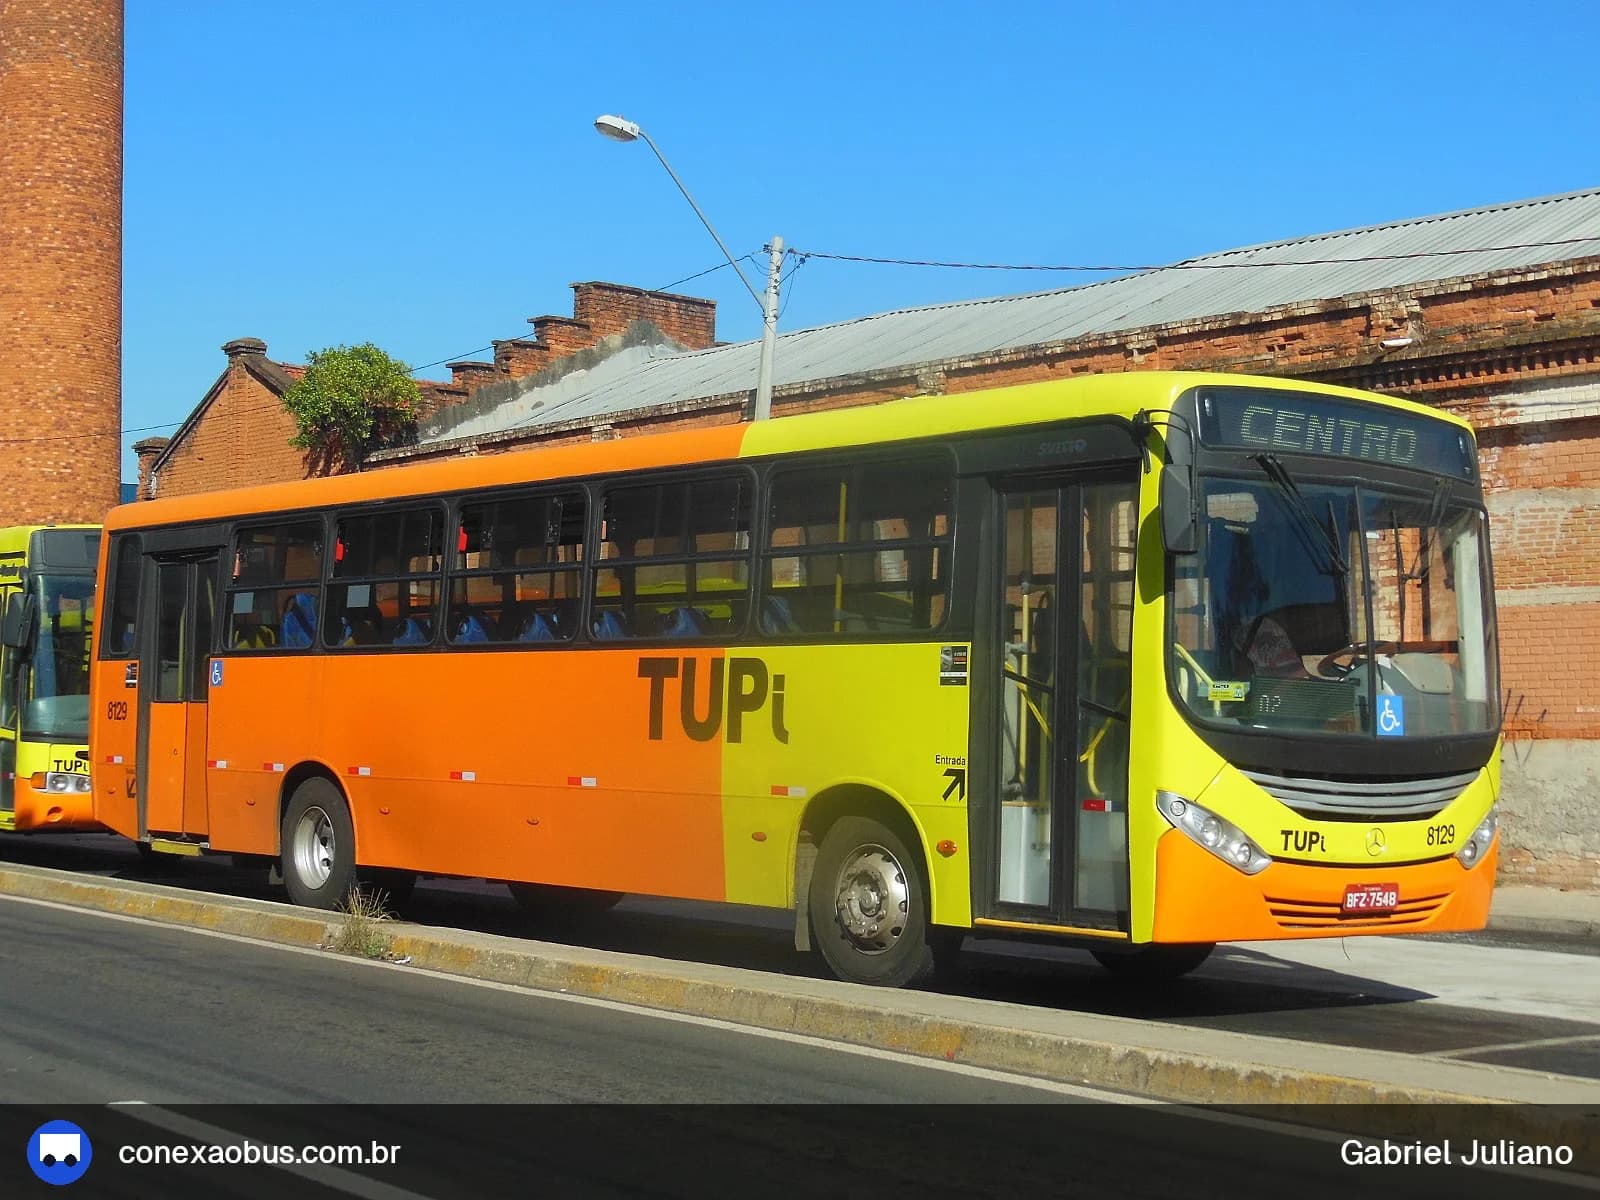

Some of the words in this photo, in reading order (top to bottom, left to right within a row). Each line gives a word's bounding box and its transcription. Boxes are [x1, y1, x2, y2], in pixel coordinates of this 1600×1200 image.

[1240, 405, 1417, 463] CENTRO
[107, 701, 128, 720] 8129
[935, 754, 966, 766] Entrada
[1426, 824, 1456, 847] 8129
